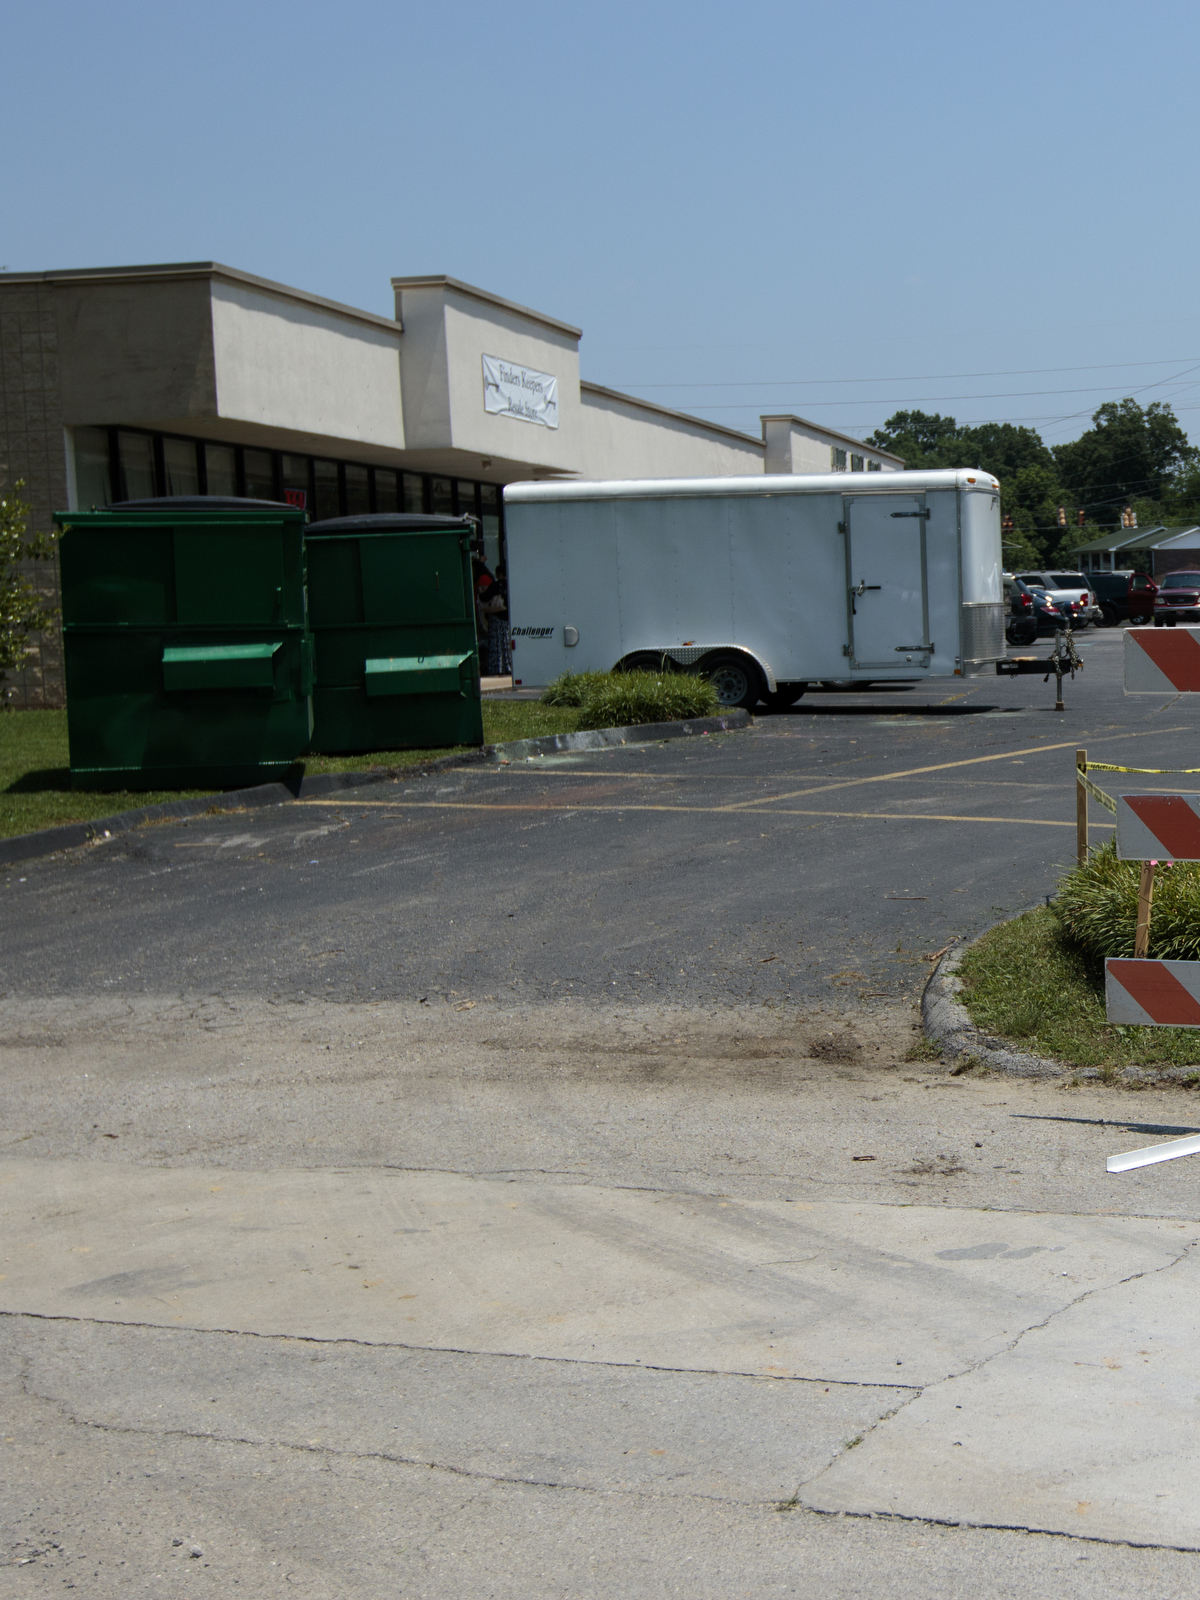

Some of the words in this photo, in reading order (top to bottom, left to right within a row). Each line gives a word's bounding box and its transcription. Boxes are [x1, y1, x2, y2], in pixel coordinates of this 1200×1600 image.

[499, 364, 521, 386] Finders
[521, 371, 544, 395] Keepers
[511, 626, 554, 636] Challenger
